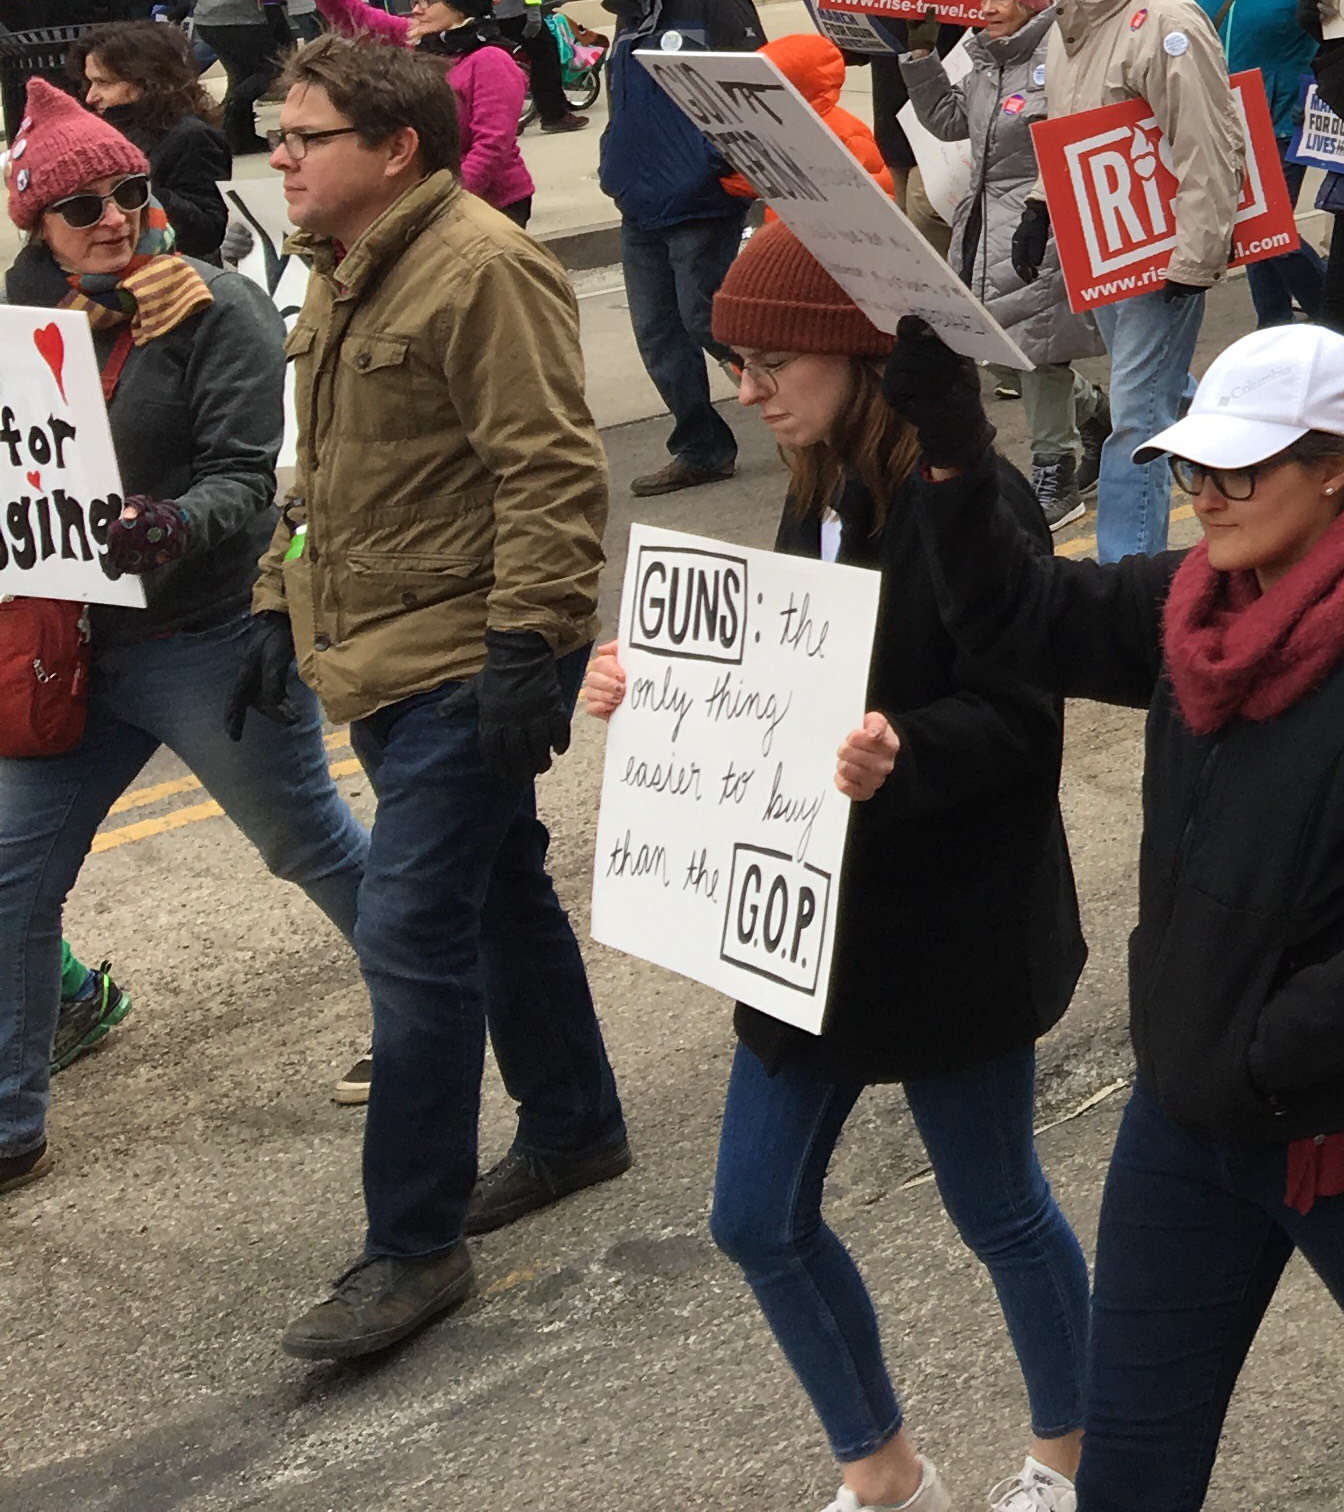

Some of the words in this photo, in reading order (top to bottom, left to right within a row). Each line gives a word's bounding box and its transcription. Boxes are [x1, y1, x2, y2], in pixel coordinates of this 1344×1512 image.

[1306, 133, 1338, 155] LIVES
[1309, 113, 1330, 134] FOR
[0, 406, 76, 469] for
[0, 489, 123, 581] ging
[779, 592, 830, 659] the
[630, 666, 693, 743] only
[704, 672, 792, 758] thing
[620, 752, 703, 802] easier
[719, 761, 755, 806] to
[761, 762, 826, 864] buy
[605, 829, 670, 889] than
[683, 848, 719, 904] the
[736, 863, 817, 970] G.O.P.
